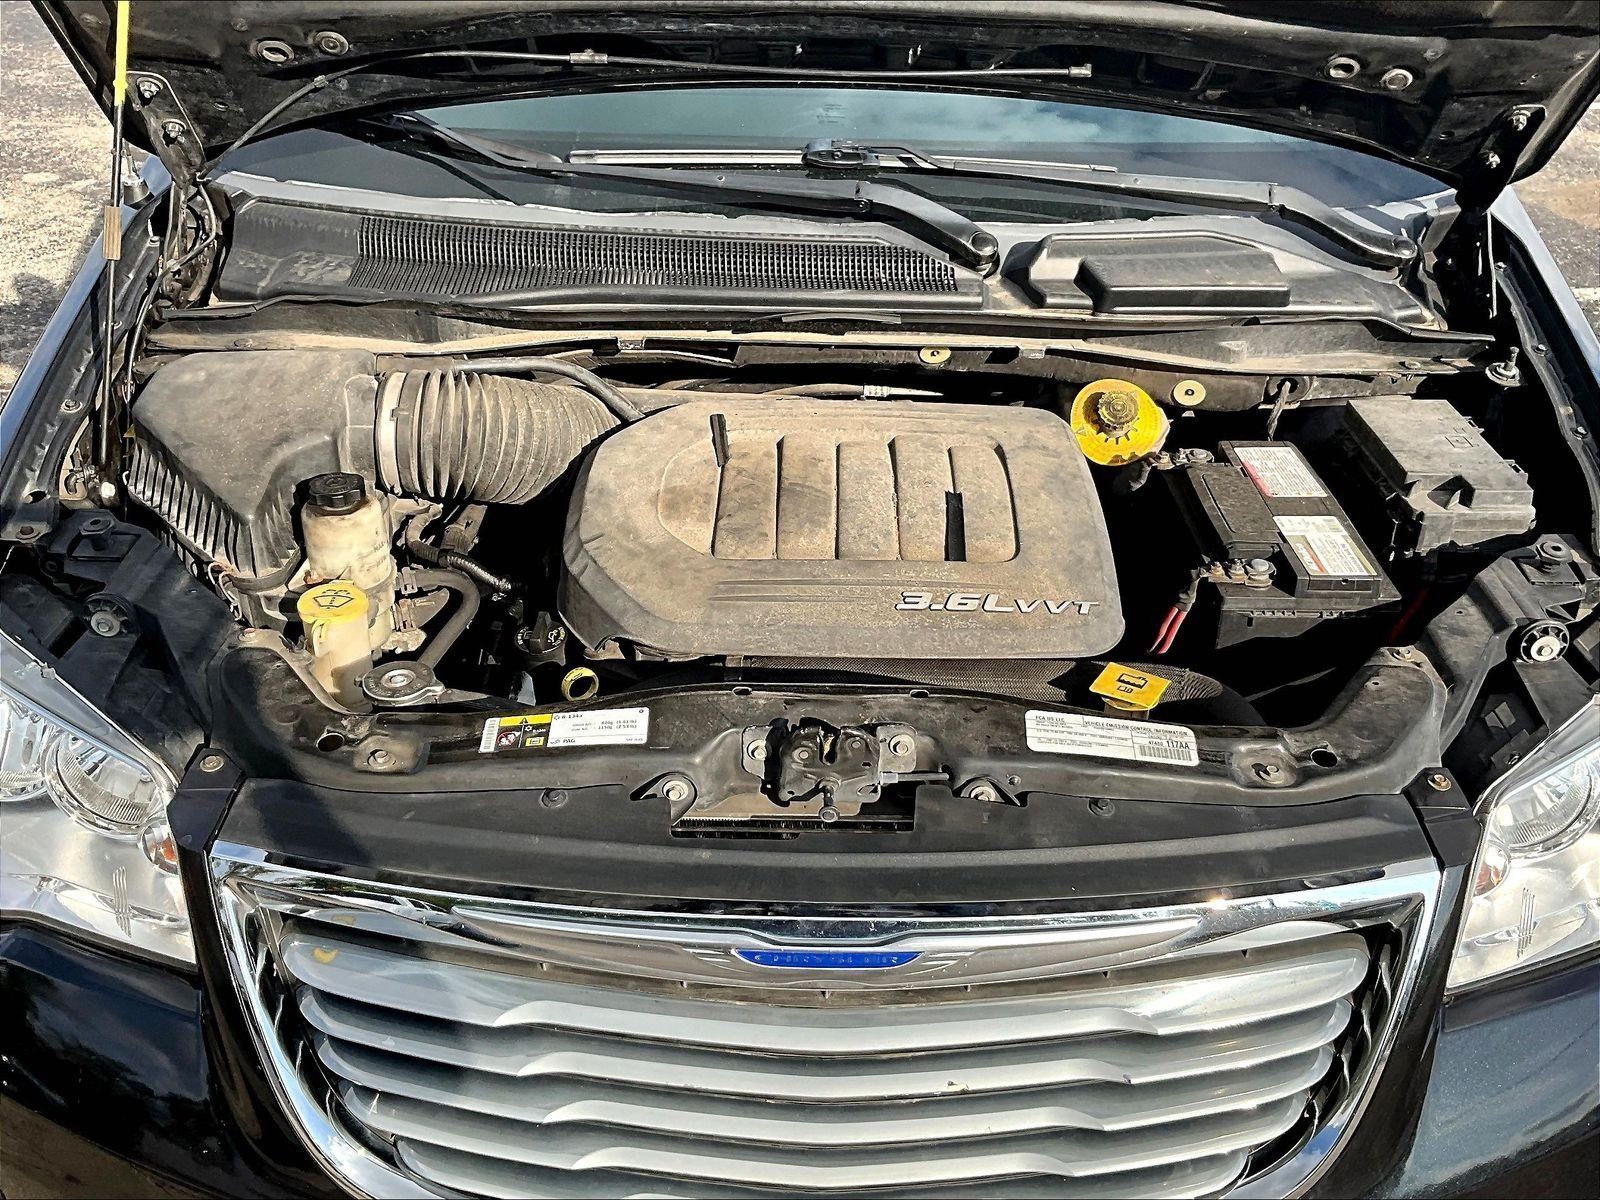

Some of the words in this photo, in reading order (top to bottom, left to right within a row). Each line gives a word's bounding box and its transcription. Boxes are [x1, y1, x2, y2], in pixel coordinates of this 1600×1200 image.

[1084, 720, 1105, 728] VEHICLE
[1105, 722, 1130, 730] EMISSION
[1130, 725, 1153, 734] CONTROL
[1153, 728, 1188, 736] INFORMATION
